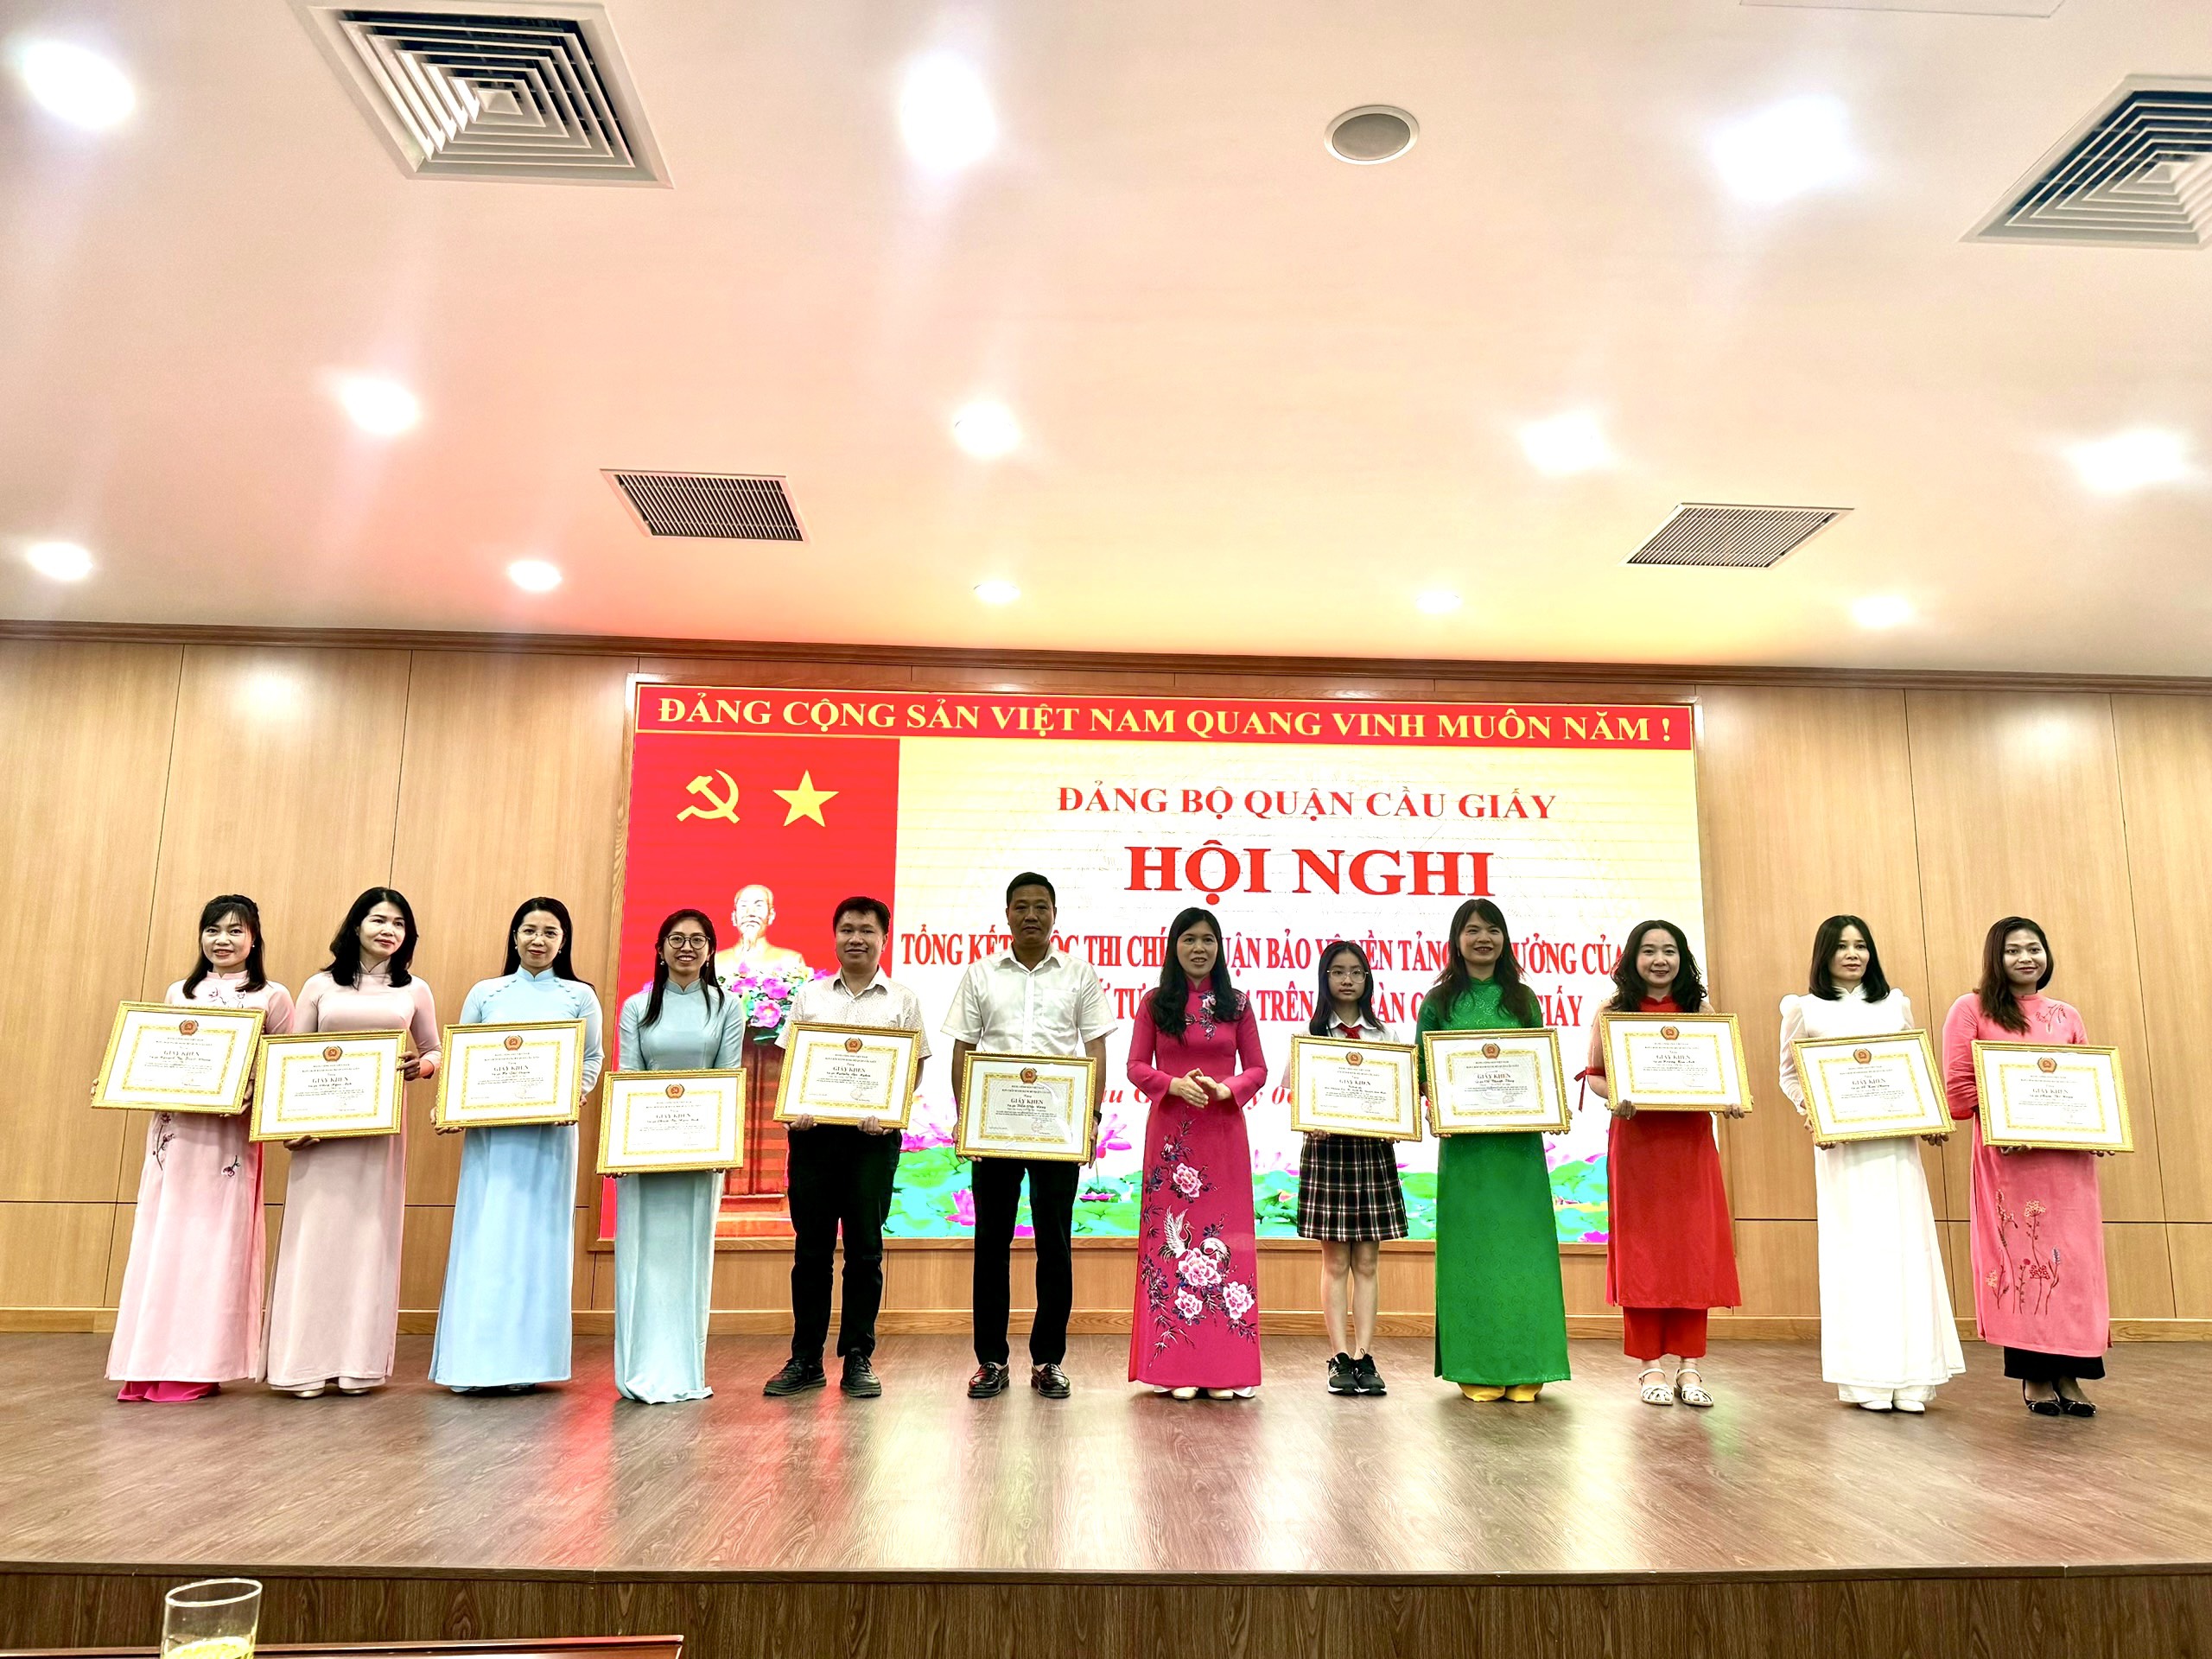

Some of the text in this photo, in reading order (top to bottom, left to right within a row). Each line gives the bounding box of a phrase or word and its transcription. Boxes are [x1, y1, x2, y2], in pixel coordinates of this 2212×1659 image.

[658, 693, 772, 725] ĐẢNG
[783, 698, 895, 733] CỘNG
[907, 700, 978, 729] SẢN
[992, 703, 1079, 736] VIỆT
[1090, 709, 1175, 733] NAM
[1187, 709, 1321, 739] QUANG
[1332, 713, 1425, 738] VINH
[1437, 708, 1552, 740] MUÔN
[1562, 709, 1650, 741] NĂM
[1058, 781, 1556, 822] ĐẢNG BỘ QUẬN CẦU GIẤY
[1124, 839, 1271, 906] HỘI
[901, 924, 963, 966] TỔNG
[1084, 935, 1122, 967] THI
[1266, 928, 1312, 969] BẢO
[1255, 981, 1314, 1022] TRÊN
